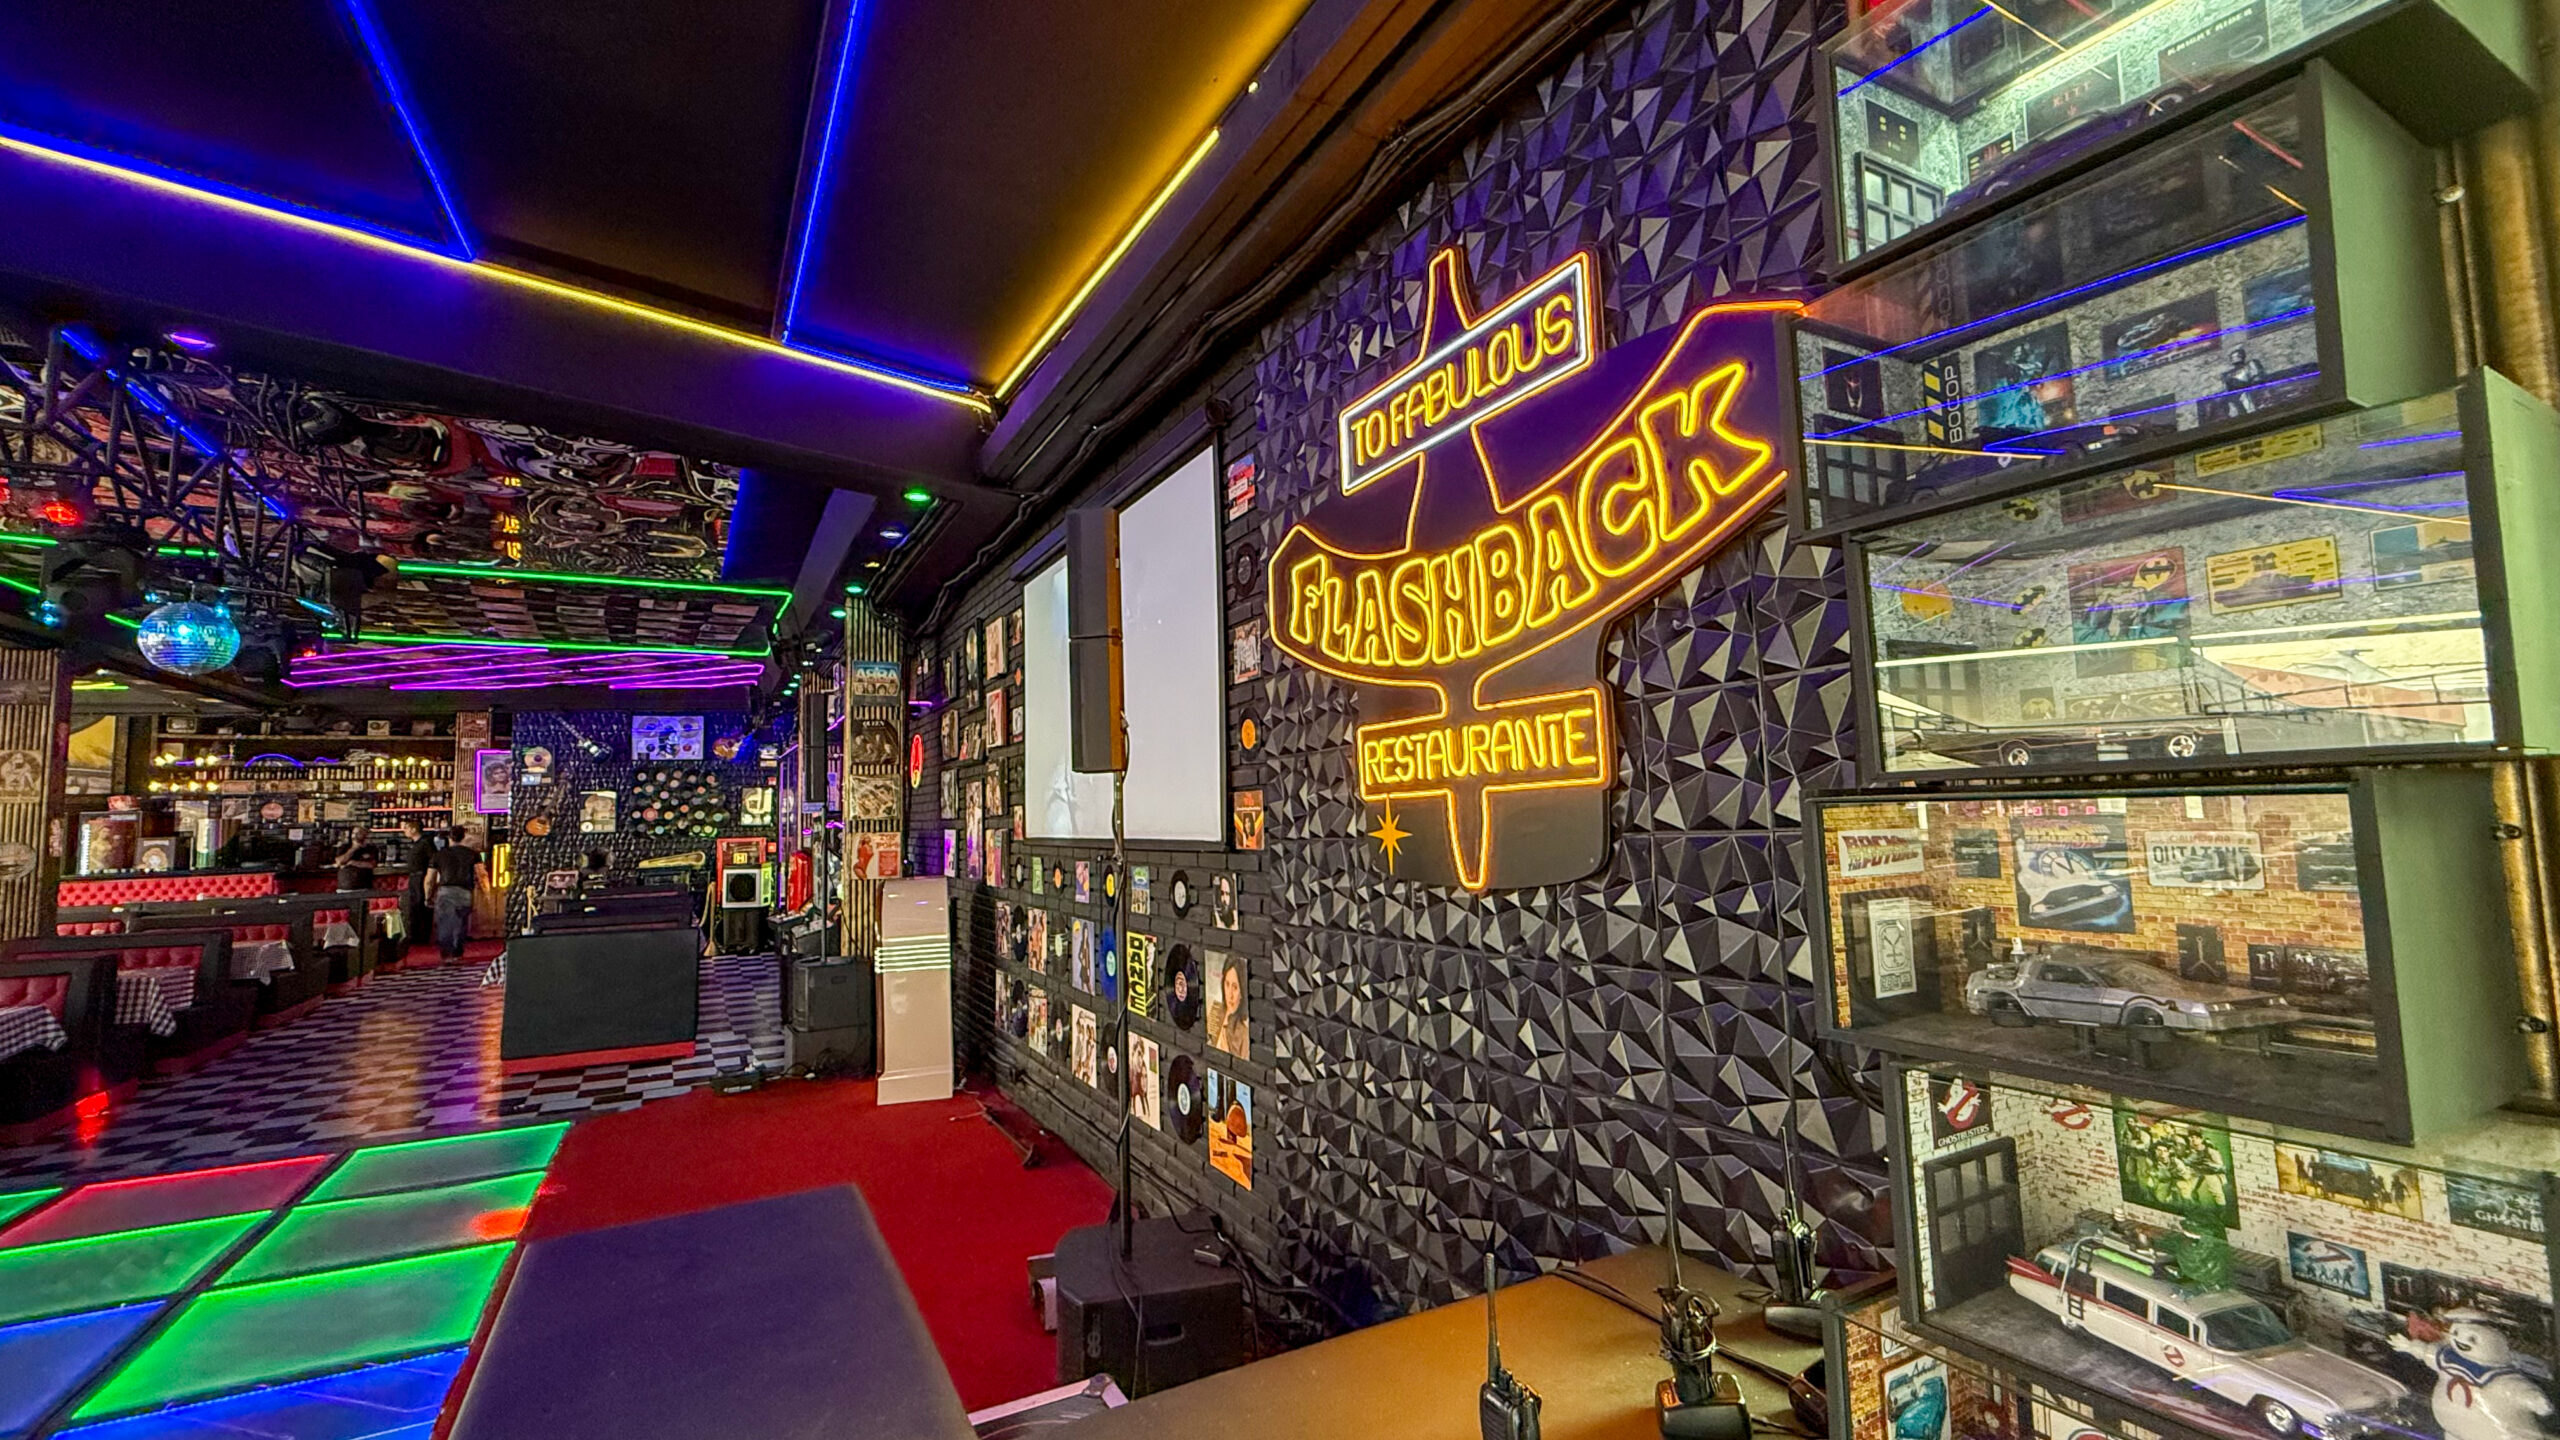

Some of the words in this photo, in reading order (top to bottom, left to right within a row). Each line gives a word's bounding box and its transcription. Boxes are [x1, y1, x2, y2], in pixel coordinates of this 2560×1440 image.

[1350, 411, 1383, 466] TO
[1388, 292, 1577, 441] FABULOUS
[1288, 361, 1774, 667] FLASHBACK
[1363, 706, 1597, 785] RESTAURANTE
[1129, 935, 1147, 1015] DANCE
[1937, 1123, 1990, 1148] GHOSTBUSTERS
